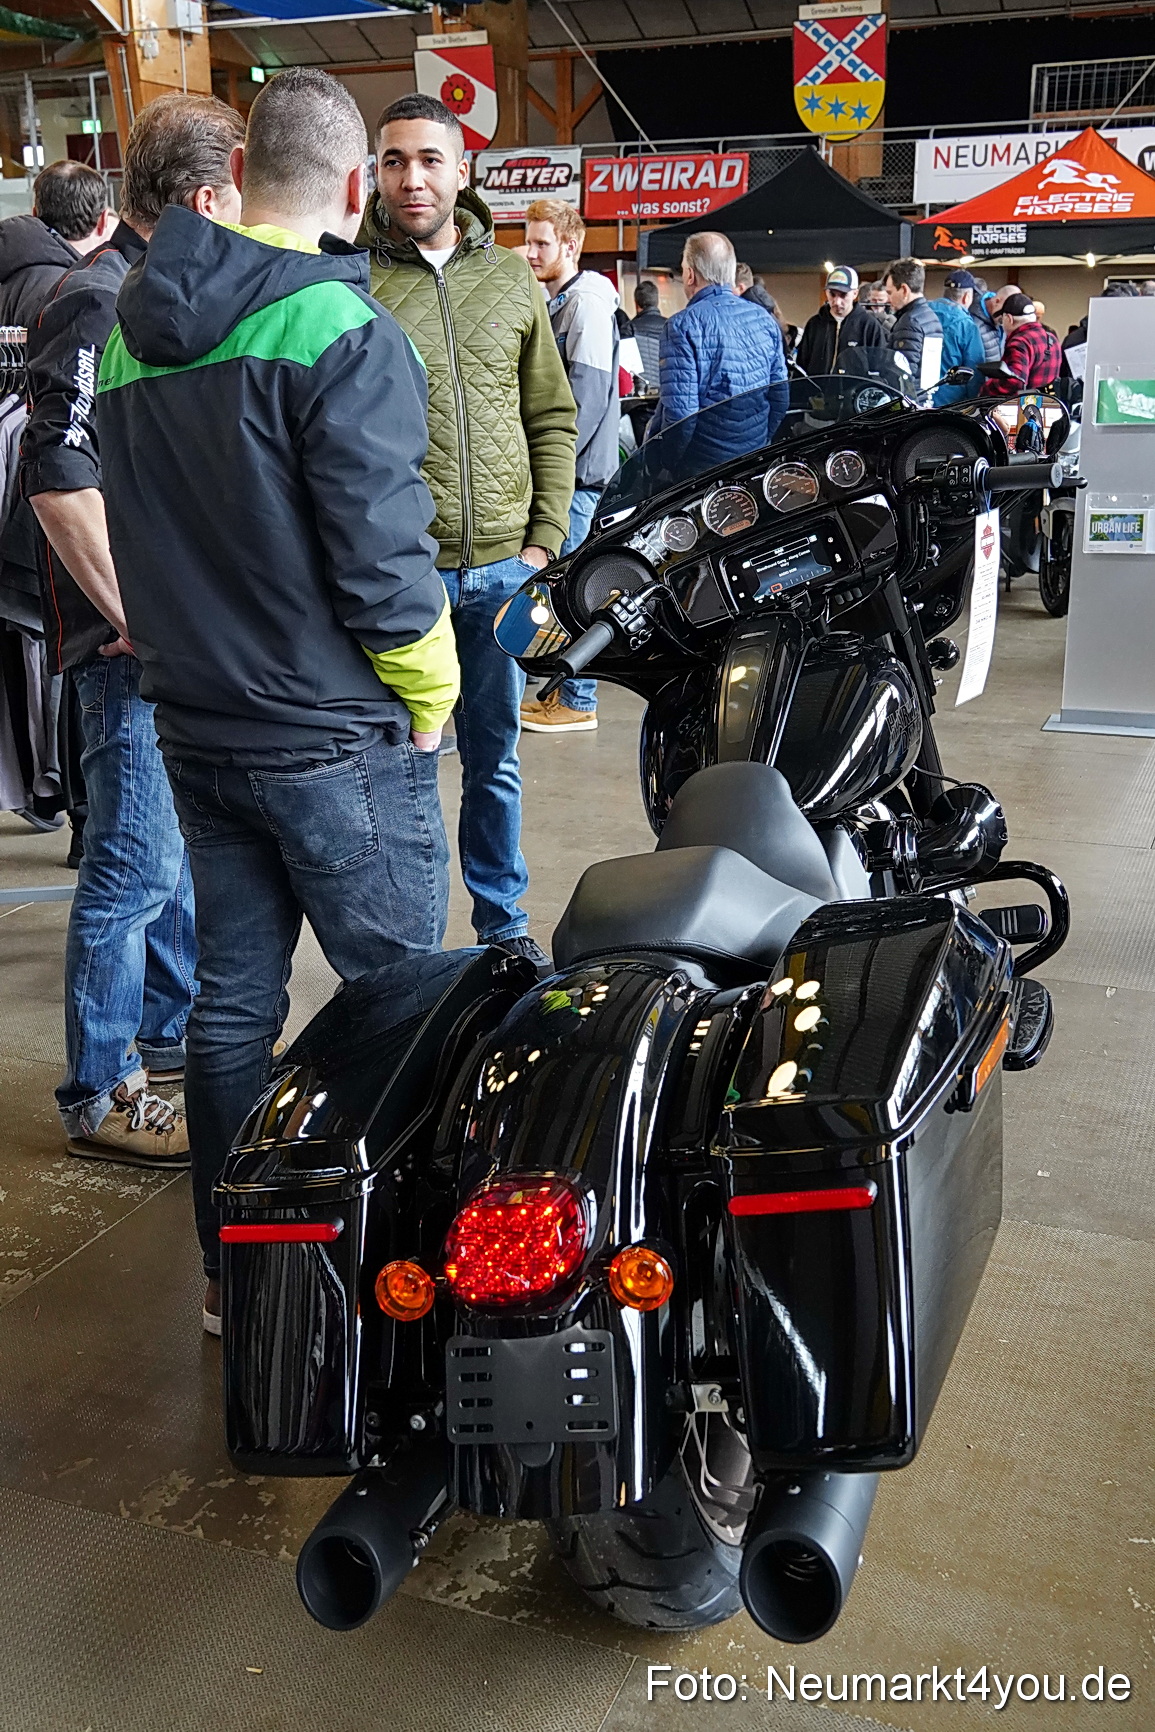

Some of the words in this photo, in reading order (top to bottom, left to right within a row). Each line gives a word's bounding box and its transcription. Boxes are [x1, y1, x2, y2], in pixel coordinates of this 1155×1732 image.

[485, 166, 570, 188] MEYER
[588, 158, 745, 193] ZWEIRAD
[1016, 192, 1135, 206] ELECTRIC
[631, 202, 660, 215] was
[662, 198, 710, 214] sonst?
[1012, 202, 1133, 217] HORSES
[971, 223, 1027, 234] ELECTRIC
[970, 232, 1027, 245] HORSES
[1091, 521, 1121, 534] URBAN
[1122, 520, 1141, 534] LIFE
